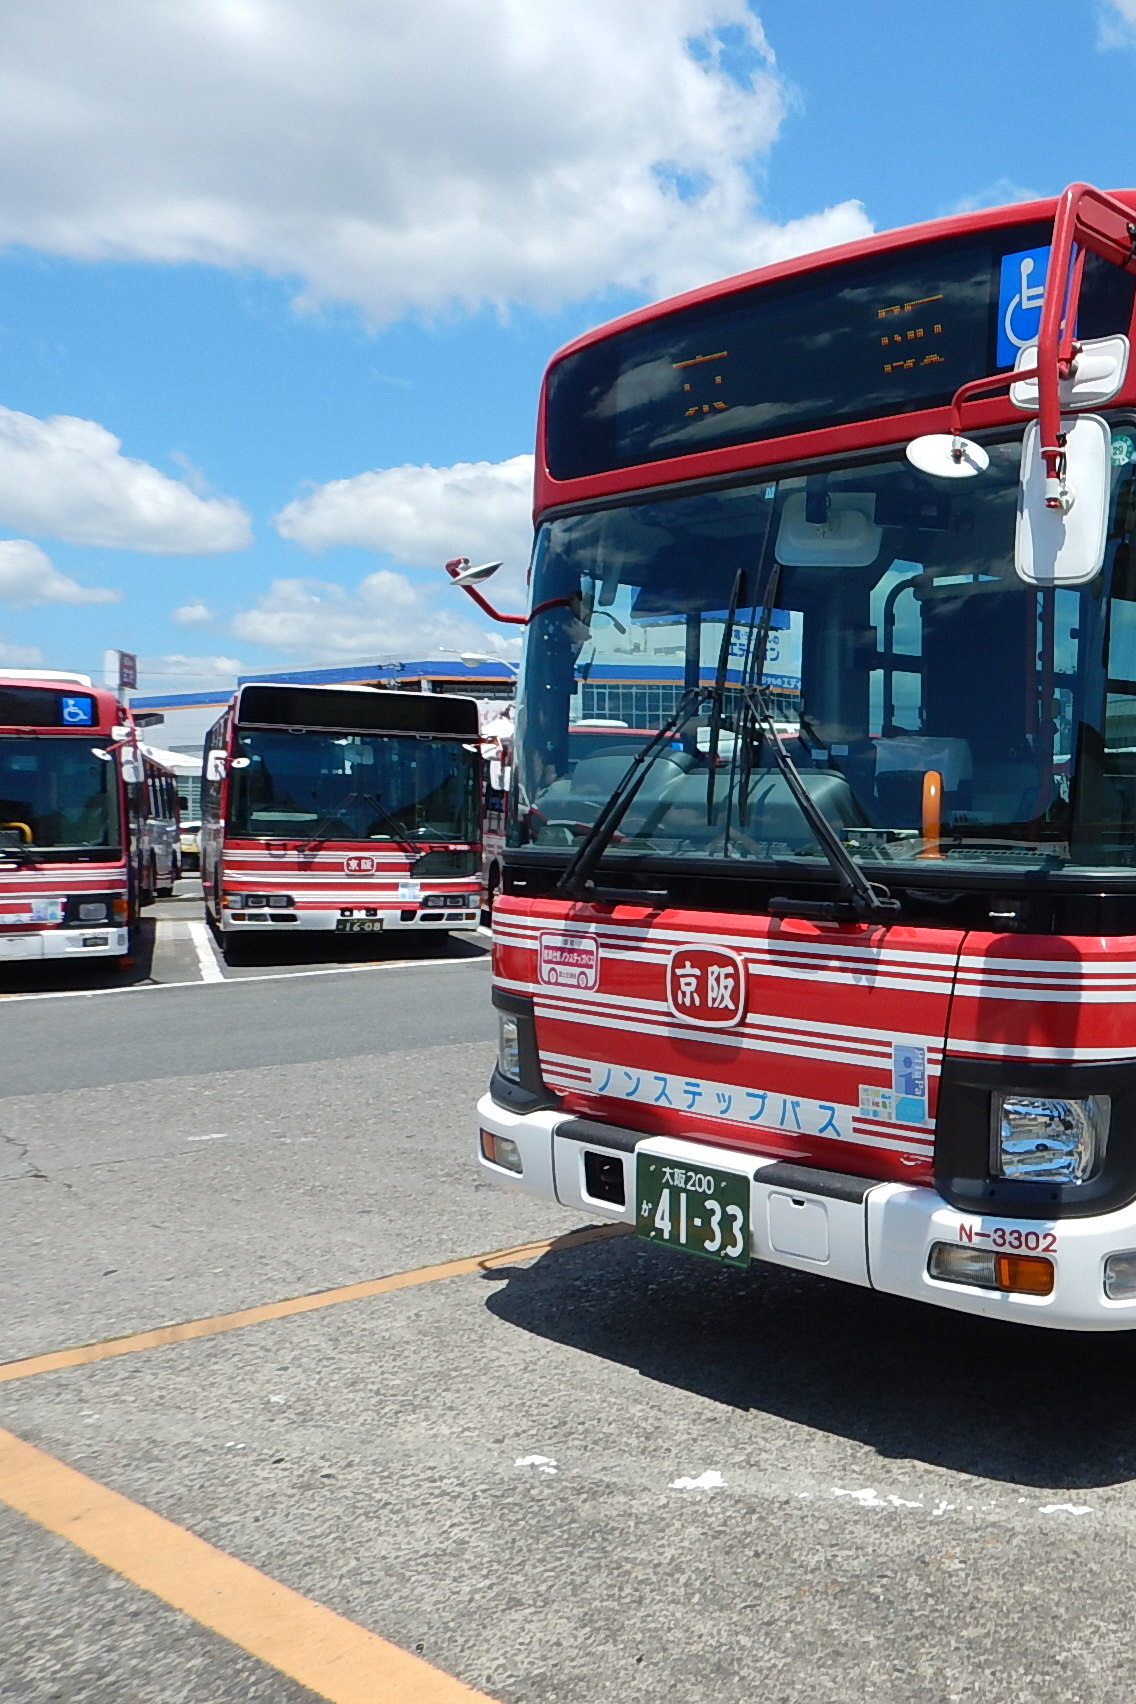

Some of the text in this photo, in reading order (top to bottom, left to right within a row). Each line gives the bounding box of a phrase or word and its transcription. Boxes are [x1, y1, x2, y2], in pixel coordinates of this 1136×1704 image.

[674, 960, 736, 1010] 京阪
[598, 1067, 842, 1137] ノンステップバス
[654, 1188, 744, 1257] 41-33
[959, 1222, 1058, 1253] N-3302
